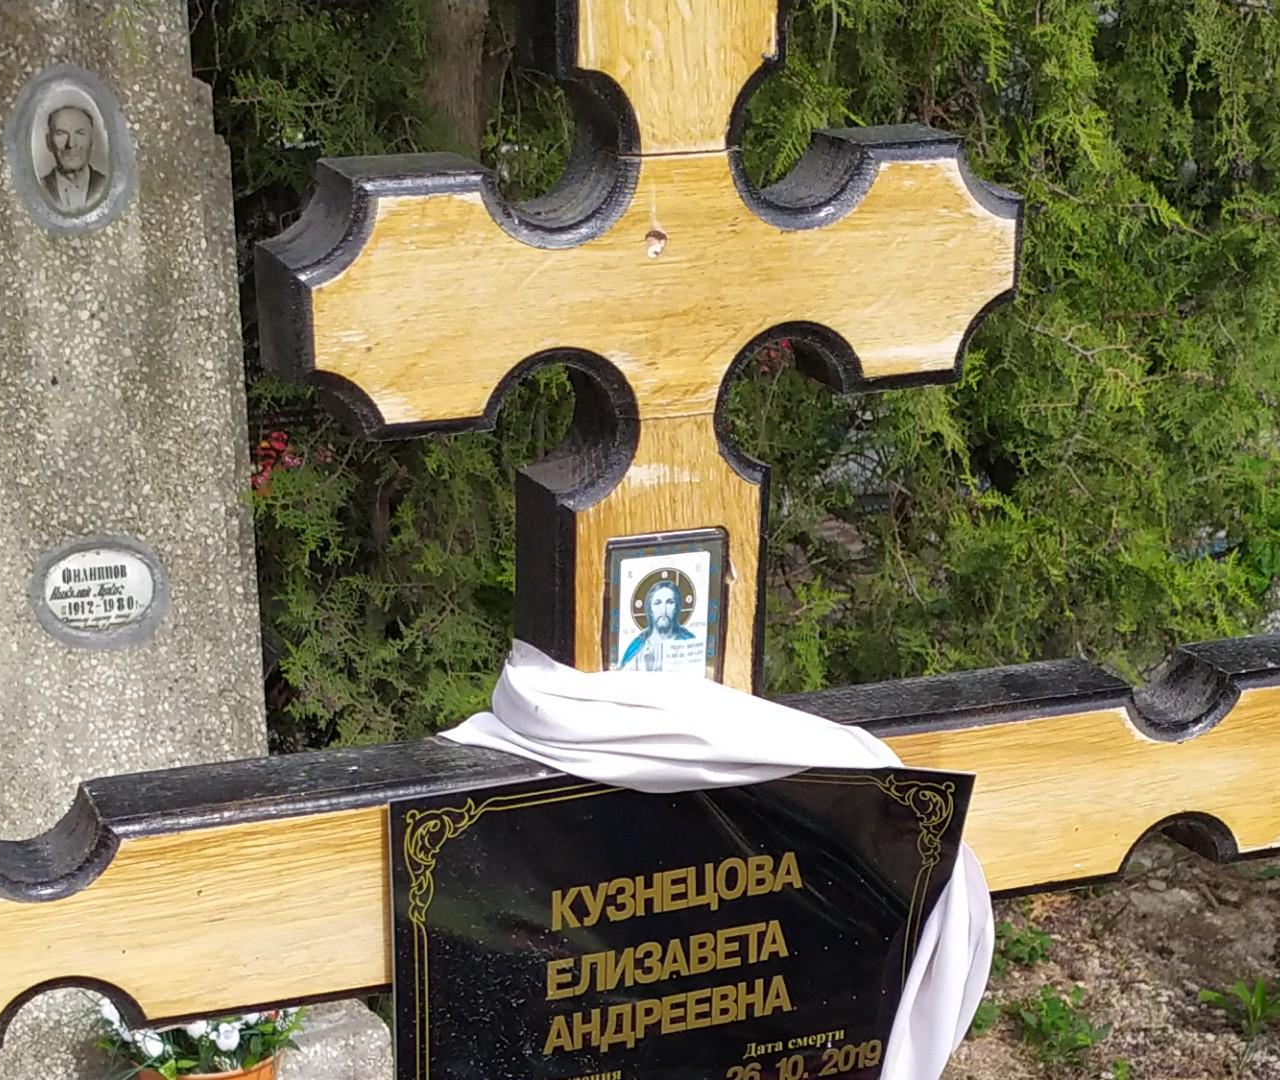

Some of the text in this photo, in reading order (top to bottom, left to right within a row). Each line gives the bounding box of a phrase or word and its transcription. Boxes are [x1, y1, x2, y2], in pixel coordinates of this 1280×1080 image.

[551, 851, 803, 931] КУЗНЕЦОВА
[546, 920, 789, 1001] ЕЛИЗАВЕТА
[543, 975, 793, 1055] АНДРЕЕВНА
[742, 1029, 845, 1060] Дата смерти
[818, 1039, 882, 1077] 2019
